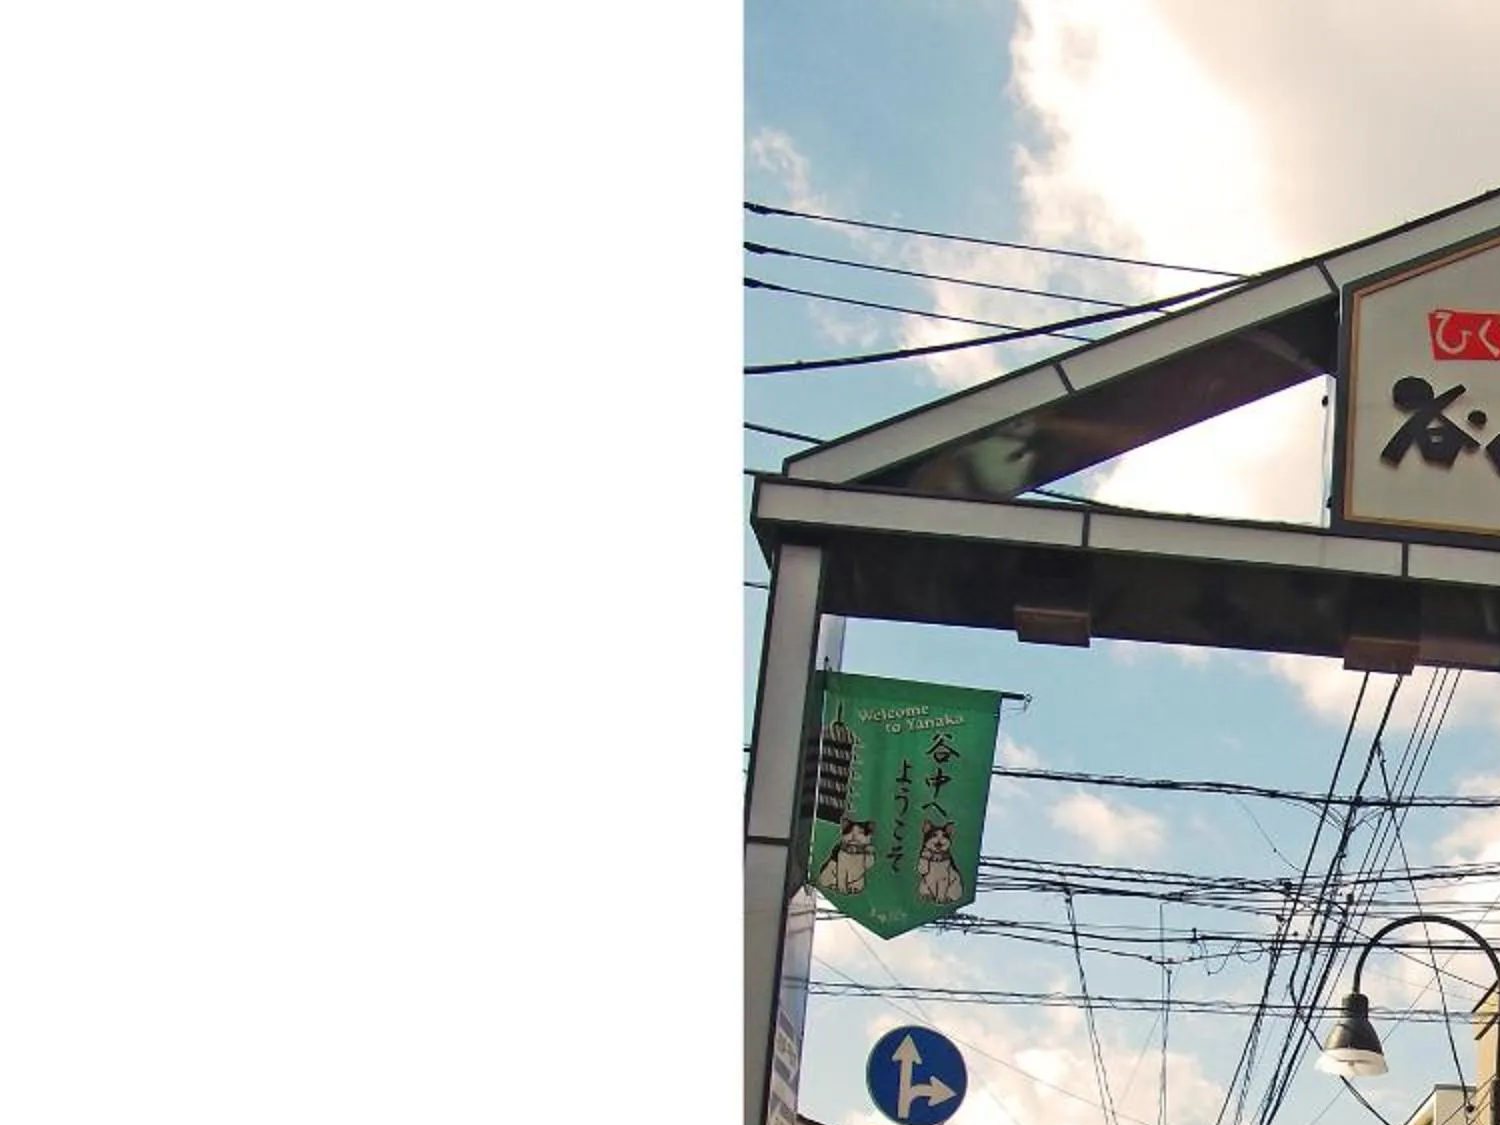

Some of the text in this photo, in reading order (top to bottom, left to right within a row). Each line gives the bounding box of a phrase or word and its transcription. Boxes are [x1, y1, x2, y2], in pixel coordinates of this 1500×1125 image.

[858, 703, 929, 723] Welcome
[885, 714, 964, 733] to Yanaka
[922, 733, 960, 817] 谷中へ
[886, 759, 912, 873] ようこそ
